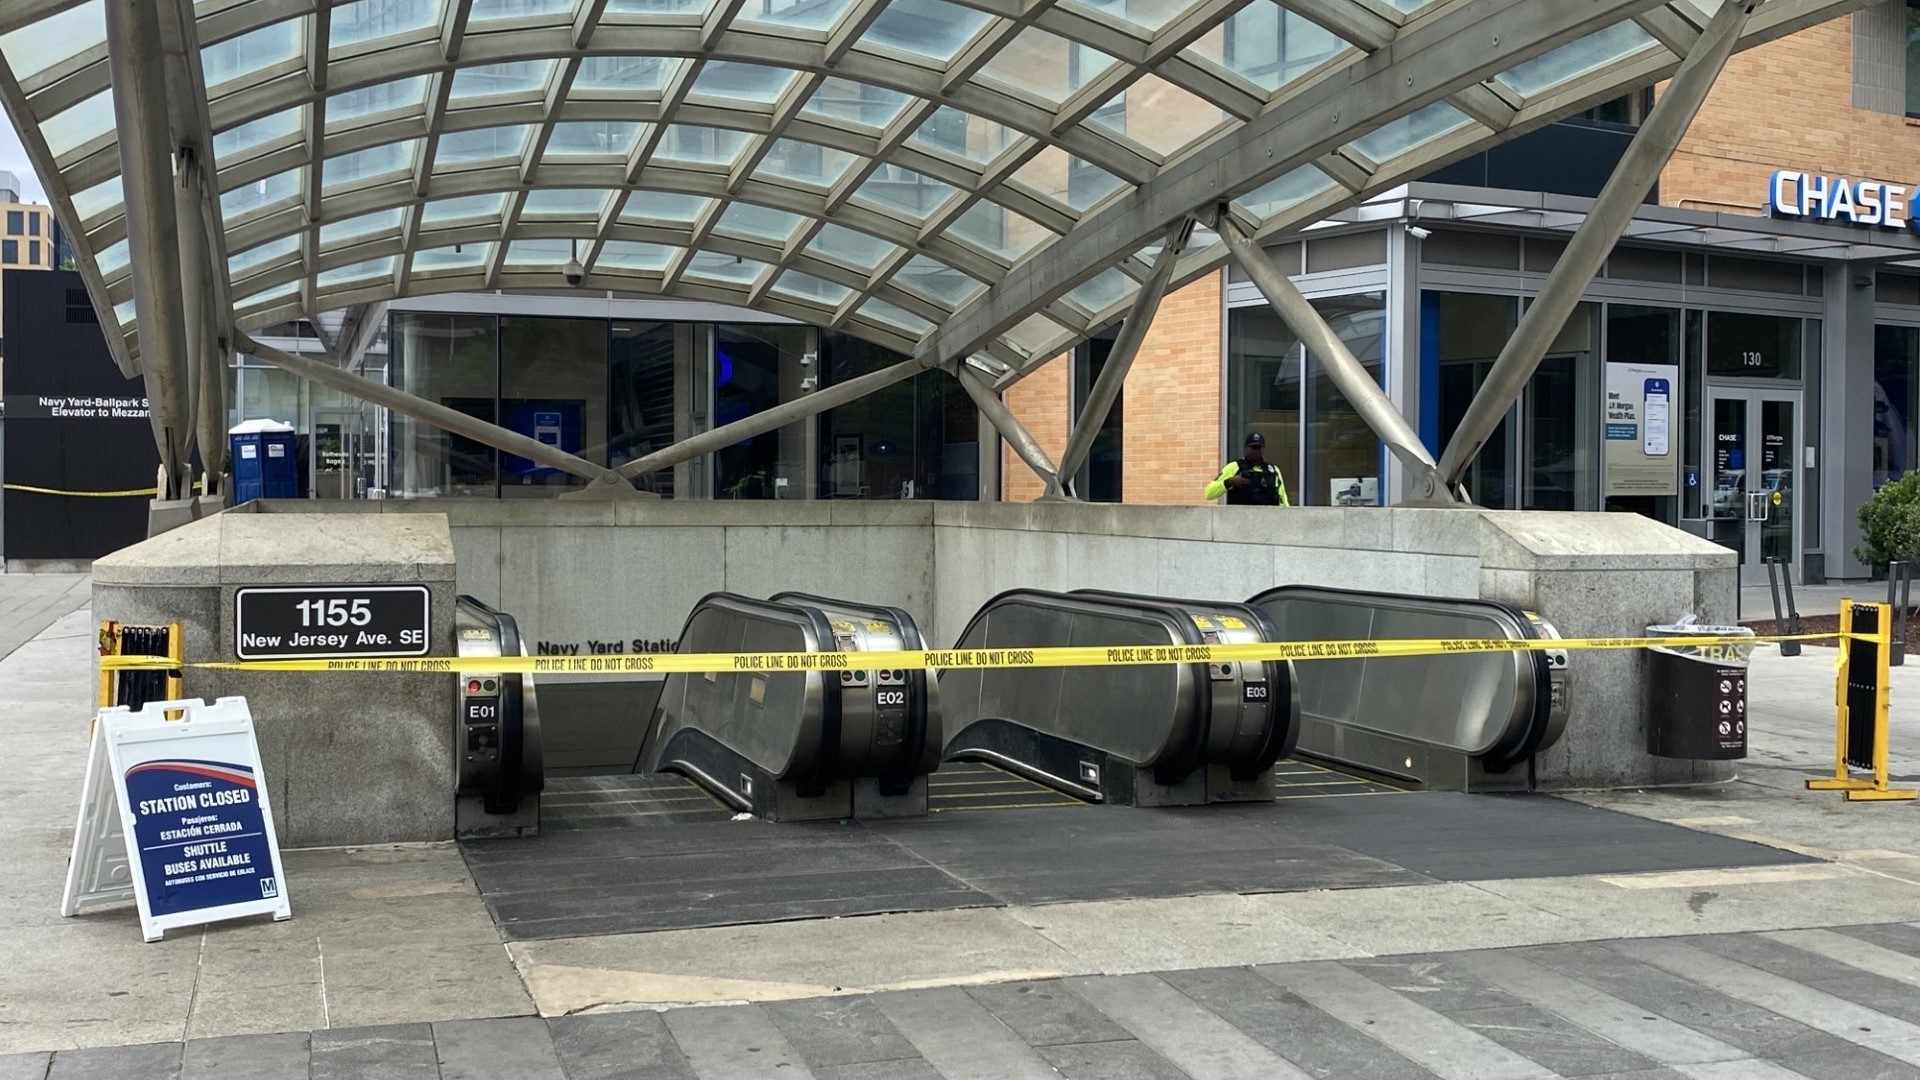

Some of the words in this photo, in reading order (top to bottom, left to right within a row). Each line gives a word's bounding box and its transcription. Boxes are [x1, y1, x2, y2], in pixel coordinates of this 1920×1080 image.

[1769, 169, 1907, 229] CHASE
[1742, 351, 1762, 367] 130
[39, 397, 66, 408] Navy
[67, 397, 139, 408] Yard-Ballpark
[52, 407, 96, 417] Elevator
[98, 407, 109, 417] to
[295, 598, 372, 627] 1155
[242, 632, 282, 648] New
[288, 631, 349, 649] Jersey
[355, 630, 392, 646] Ave.
[399, 629, 424, 645] SE
[537, 640, 579, 657] Navy
[587, 640, 624, 654] Yard
[1107, 649, 1135, 662] POLICE
[1136, 648, 1154, 662] LINE
[1156, 648, 1167, 661] DO
[1167, 647, 1184, 661] NOT
[1185, 646, 1211, 660] CROSS
[1279, 644, 1306, 658] POLICE
[1307, 644, 1324, 657] LINE
[1326, 643, 1337, 656] DO
[1338, 643, 1354, 655] NOT
[1354, 642, 1379, 655] CROSS
[328, 661, 360, 669] POLICE
[363, 660, 381, 670] LINE
[386, 661, 398, 671] DO
[400, 660, 418, 671] NOT
[420, 660, 451, 671] CROSS
[535, 659, 566, 671] POLICE
[567, 658, 587, 671] LINE
[590, 658, 602, 670] DO
[604, 658, 623, 671] NOT
[625, 657, 654, 670] CROSS
[734, 656, 764, 669] POLICE
[766, 655, 784, 668] LINE
[787, 655, 799, 668] DO
[800, 655, 818, 668] NOT
[819, 654, 847, 668] CROSS
[924, 653, 953, 666] POLICE
[955, 652, 973, 666] LINE
[975, 652, 988, 665] DO
[989, 651, 1007, 665] NOT
[1007, 650, 1034, 664] CROSS
[877, 691, 904, 705] E02
[1246, 687, 1267, 698] E03
[469, 706, 495, 718] E01
[173, 781, 212, 792] Customers:
[139, 794, 198, 816] STATION
[200, 788, 250, 808] CLOSED
[181, 814, 219, 826] Pasajeros:
[160, 825, 202, 841] ESTACIÓN
[203, 821, 243, 836] CERRADA
[183, 841, 228, 858] SHUTTLE
[164, 860, 198, 876] BUSES
[200, 853, 252, 871] AVAILABLE
[261, 878, 275, 892] M
